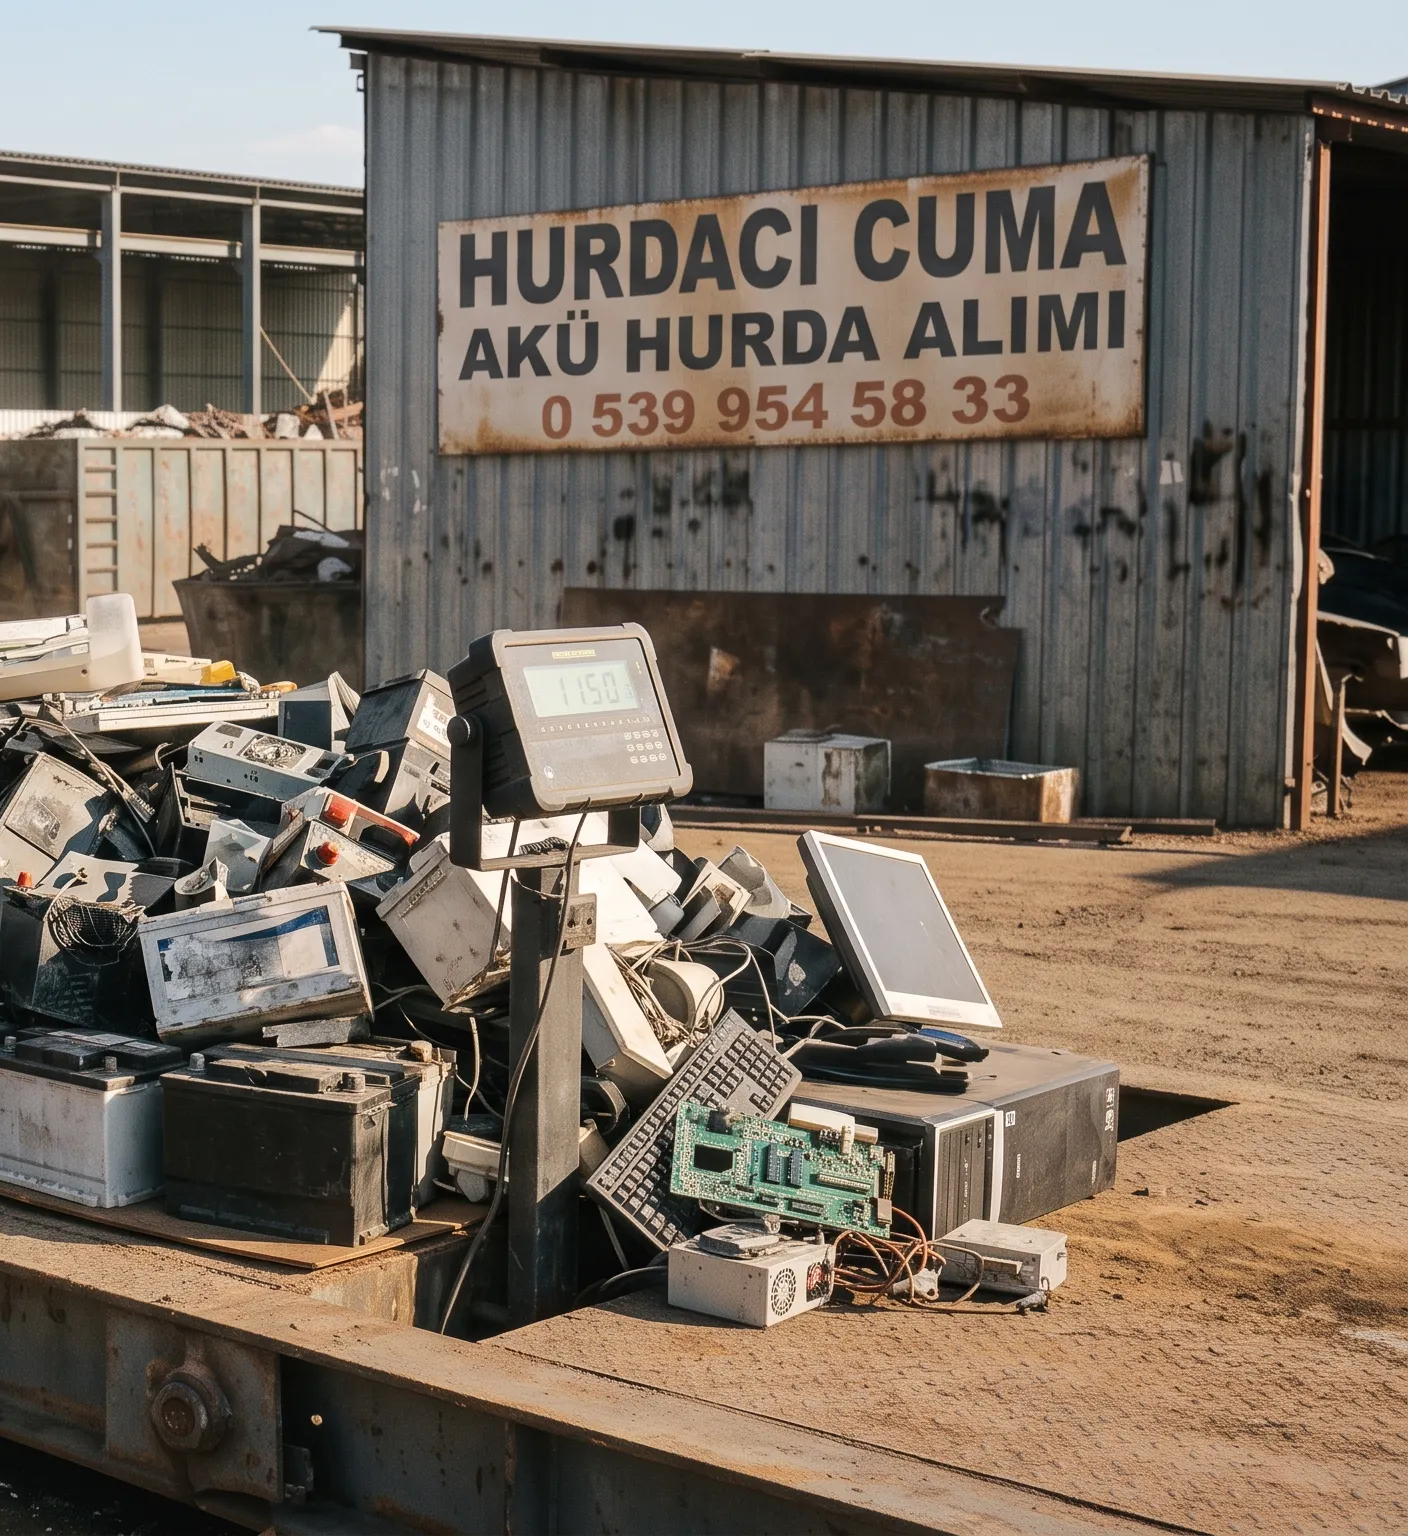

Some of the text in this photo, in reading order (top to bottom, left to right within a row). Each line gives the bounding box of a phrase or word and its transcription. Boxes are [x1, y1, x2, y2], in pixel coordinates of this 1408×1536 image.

[459, 181, 1127, 308] HURDACI CUMA
[458, 289, 1126, 381] AKÜ HURDA ALIMI
[541, 374, 1032, 440] 0 539 954 58 33
